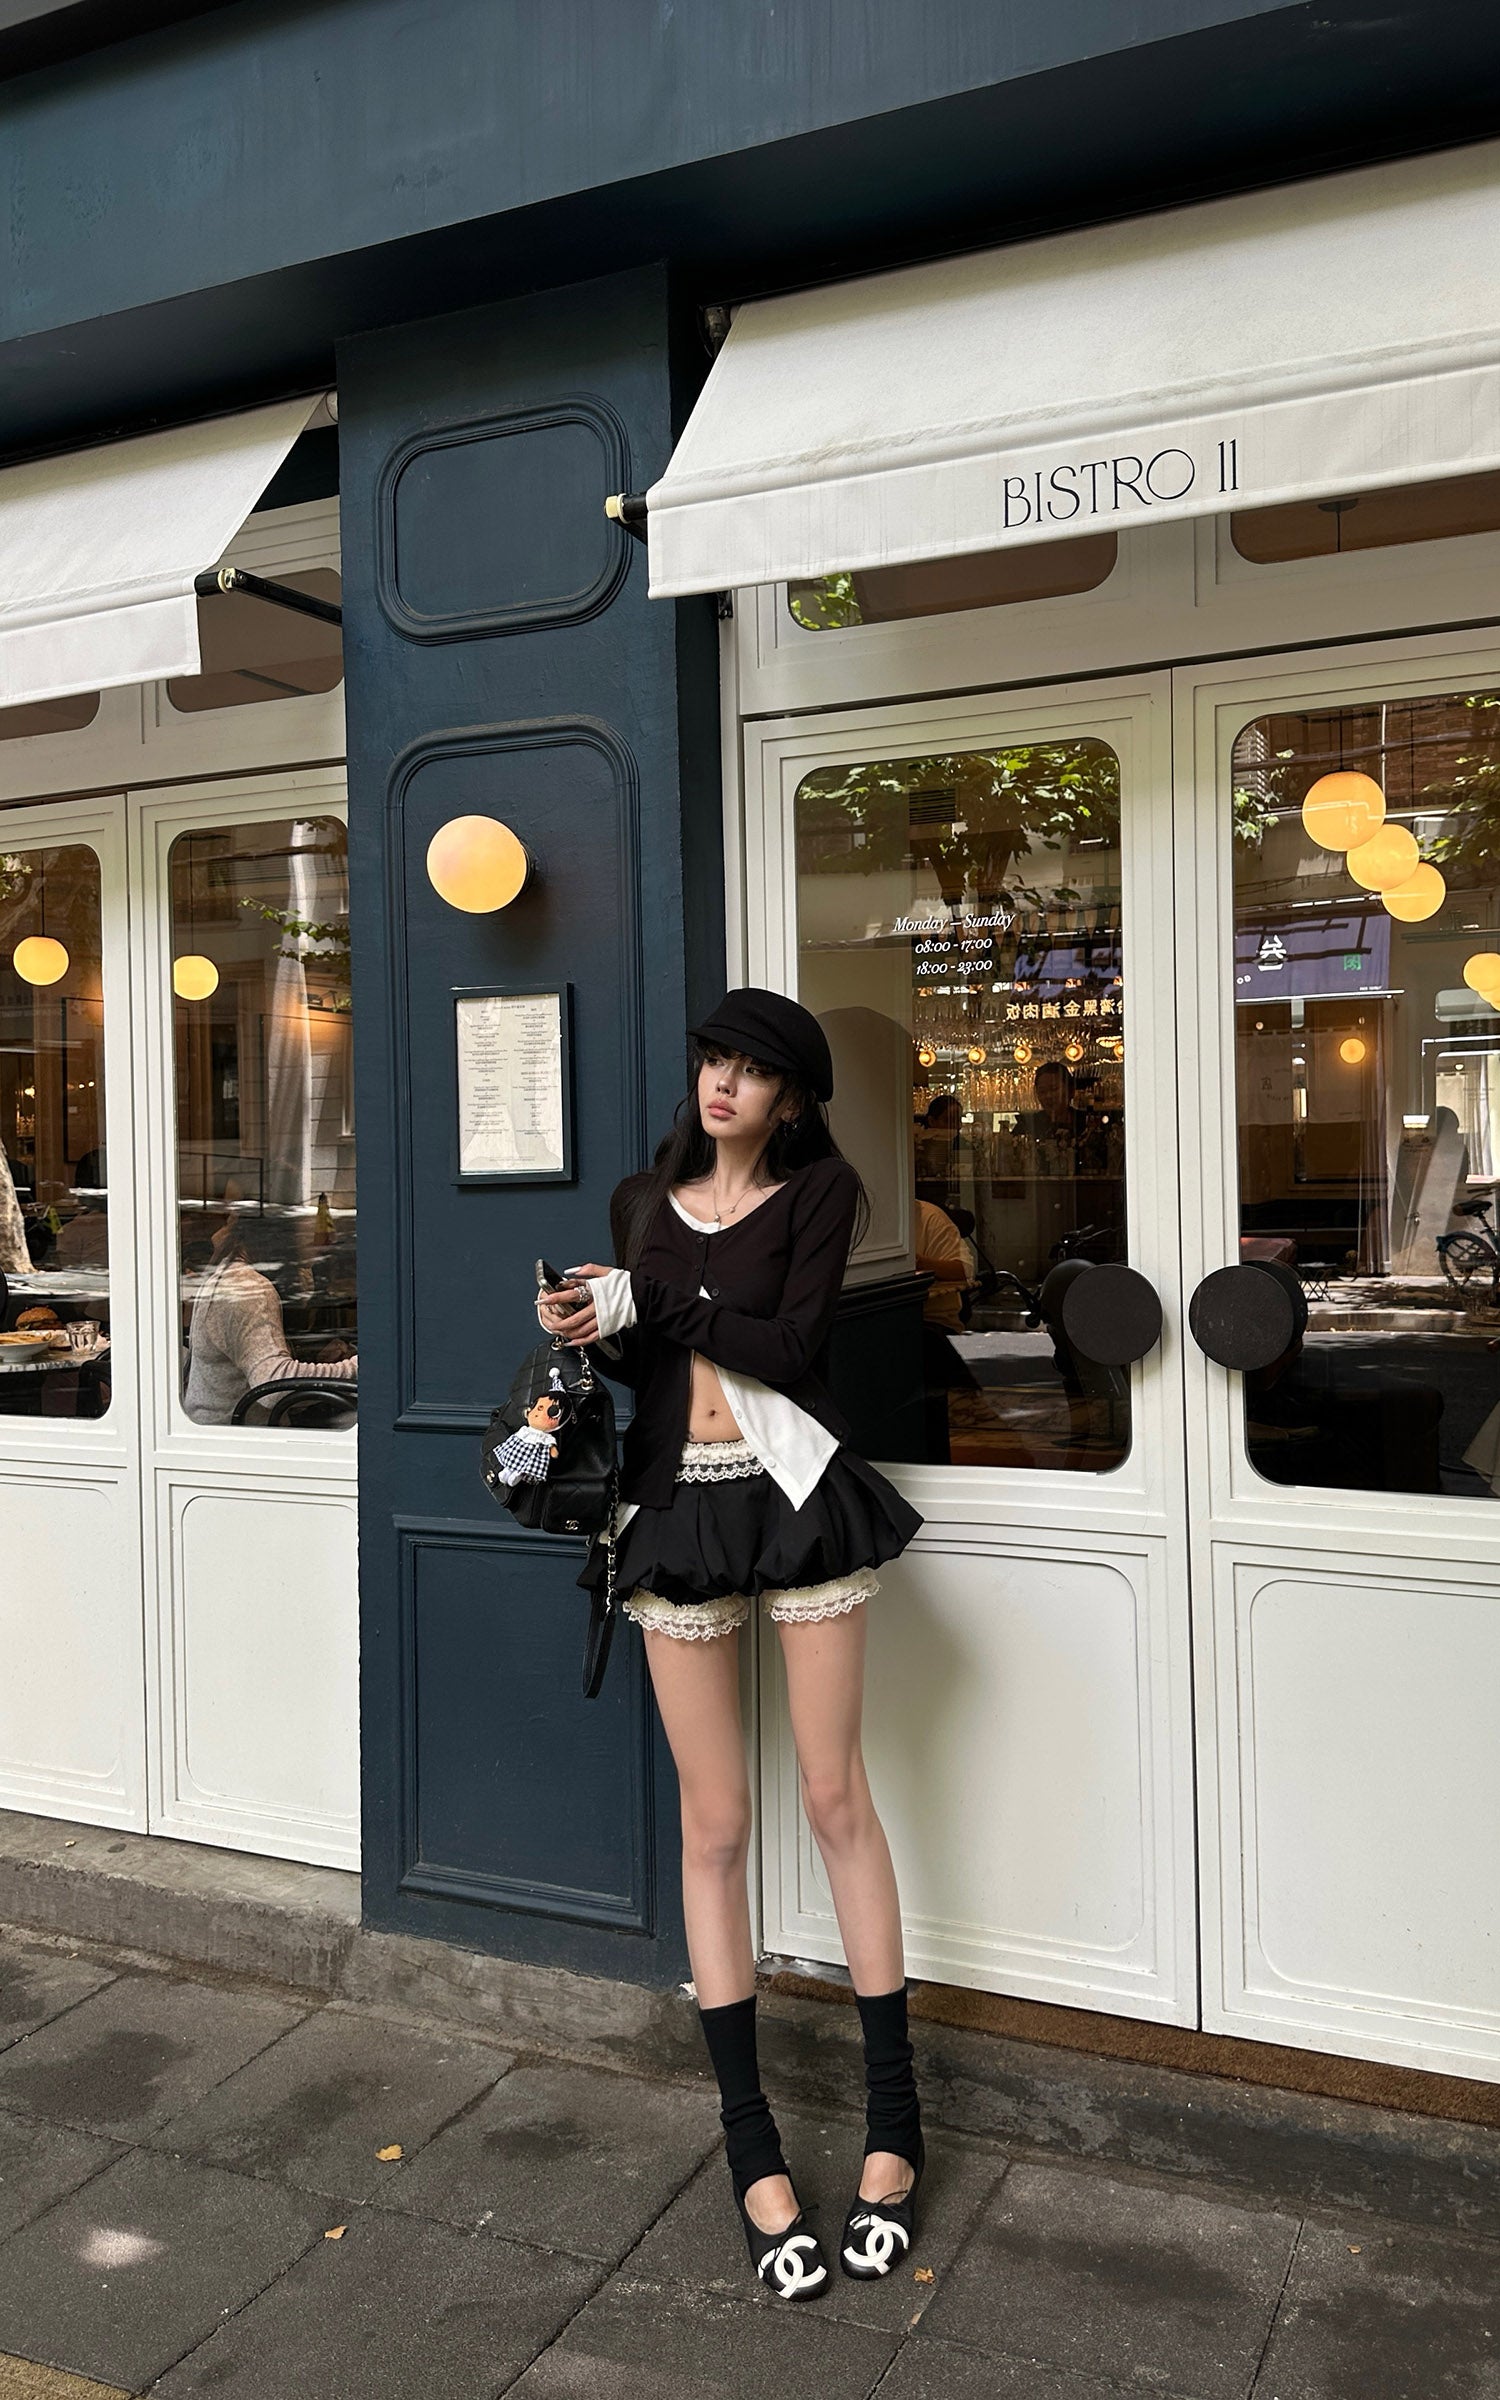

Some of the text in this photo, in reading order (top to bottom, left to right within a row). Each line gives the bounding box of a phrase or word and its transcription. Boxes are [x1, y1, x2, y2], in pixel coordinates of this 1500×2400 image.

[1003, 438, 1239, 528] BISTRO 11
[892, 916, 948, 932] Monday
[963, 911, 1016, 931] Sunday
[915, 940, 950, 954] 08:00
[961, 938, 993, 953] 17:00
[916, 962, 948, 976] 18:00
[957, 960, 993, 976] 23:00
